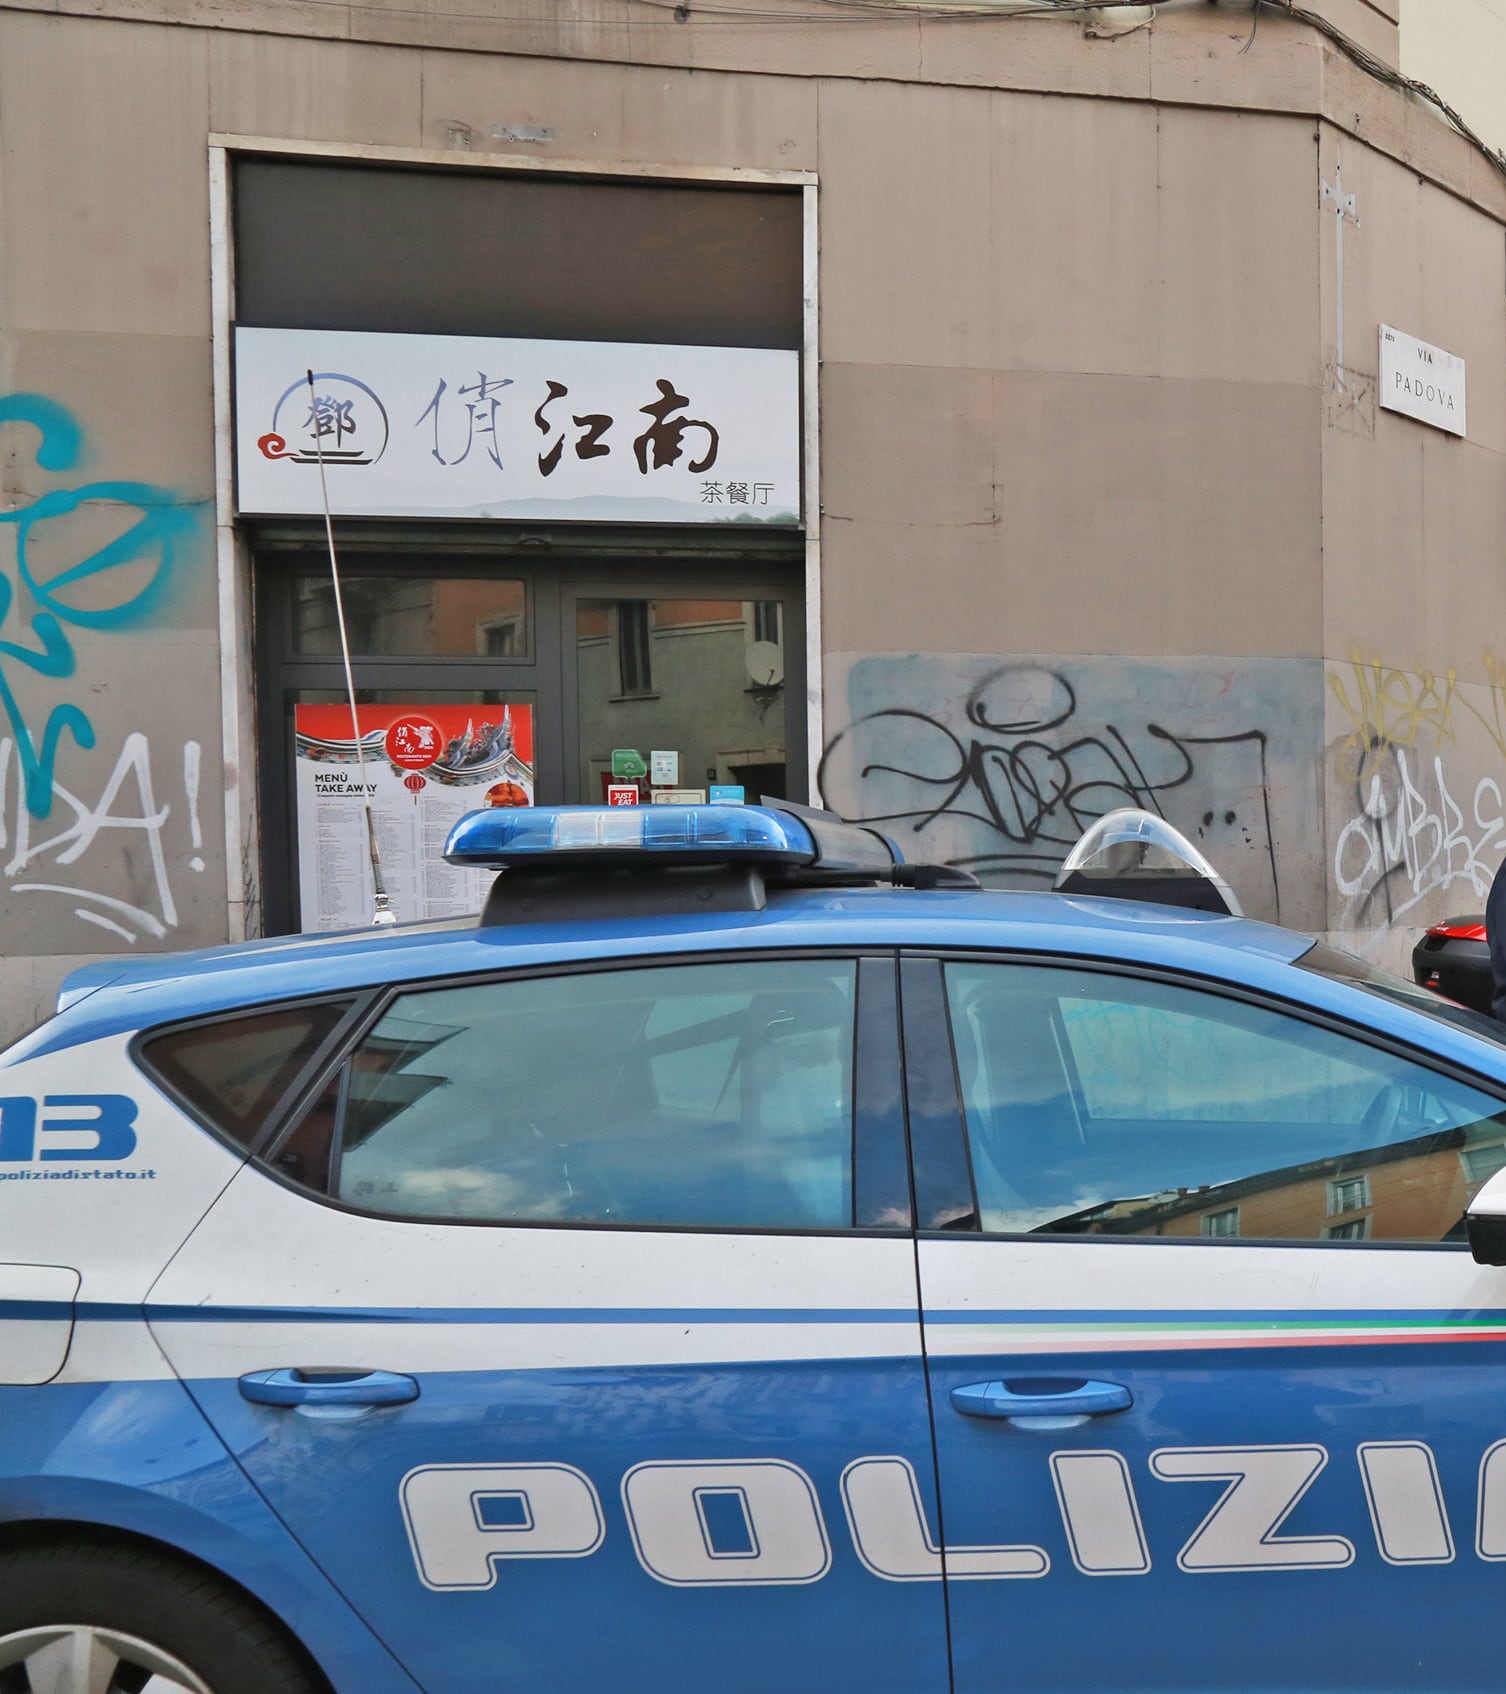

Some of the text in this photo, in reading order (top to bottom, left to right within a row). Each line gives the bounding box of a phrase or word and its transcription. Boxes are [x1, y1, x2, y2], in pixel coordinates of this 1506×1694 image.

[1417, 347, 1433, 364] VIA
[1395, 371, 1454, 410] PADOVA
[414, 371, 721, 478] 俏江南
[699, 480, 775, 505] 茶餐厅
[314, 772, 348, 783] MENÙ
[314, 784, 343, 793] TAKE
[613, 792, 633, 801] JUST
[0, 731, 205, 928] DA!
